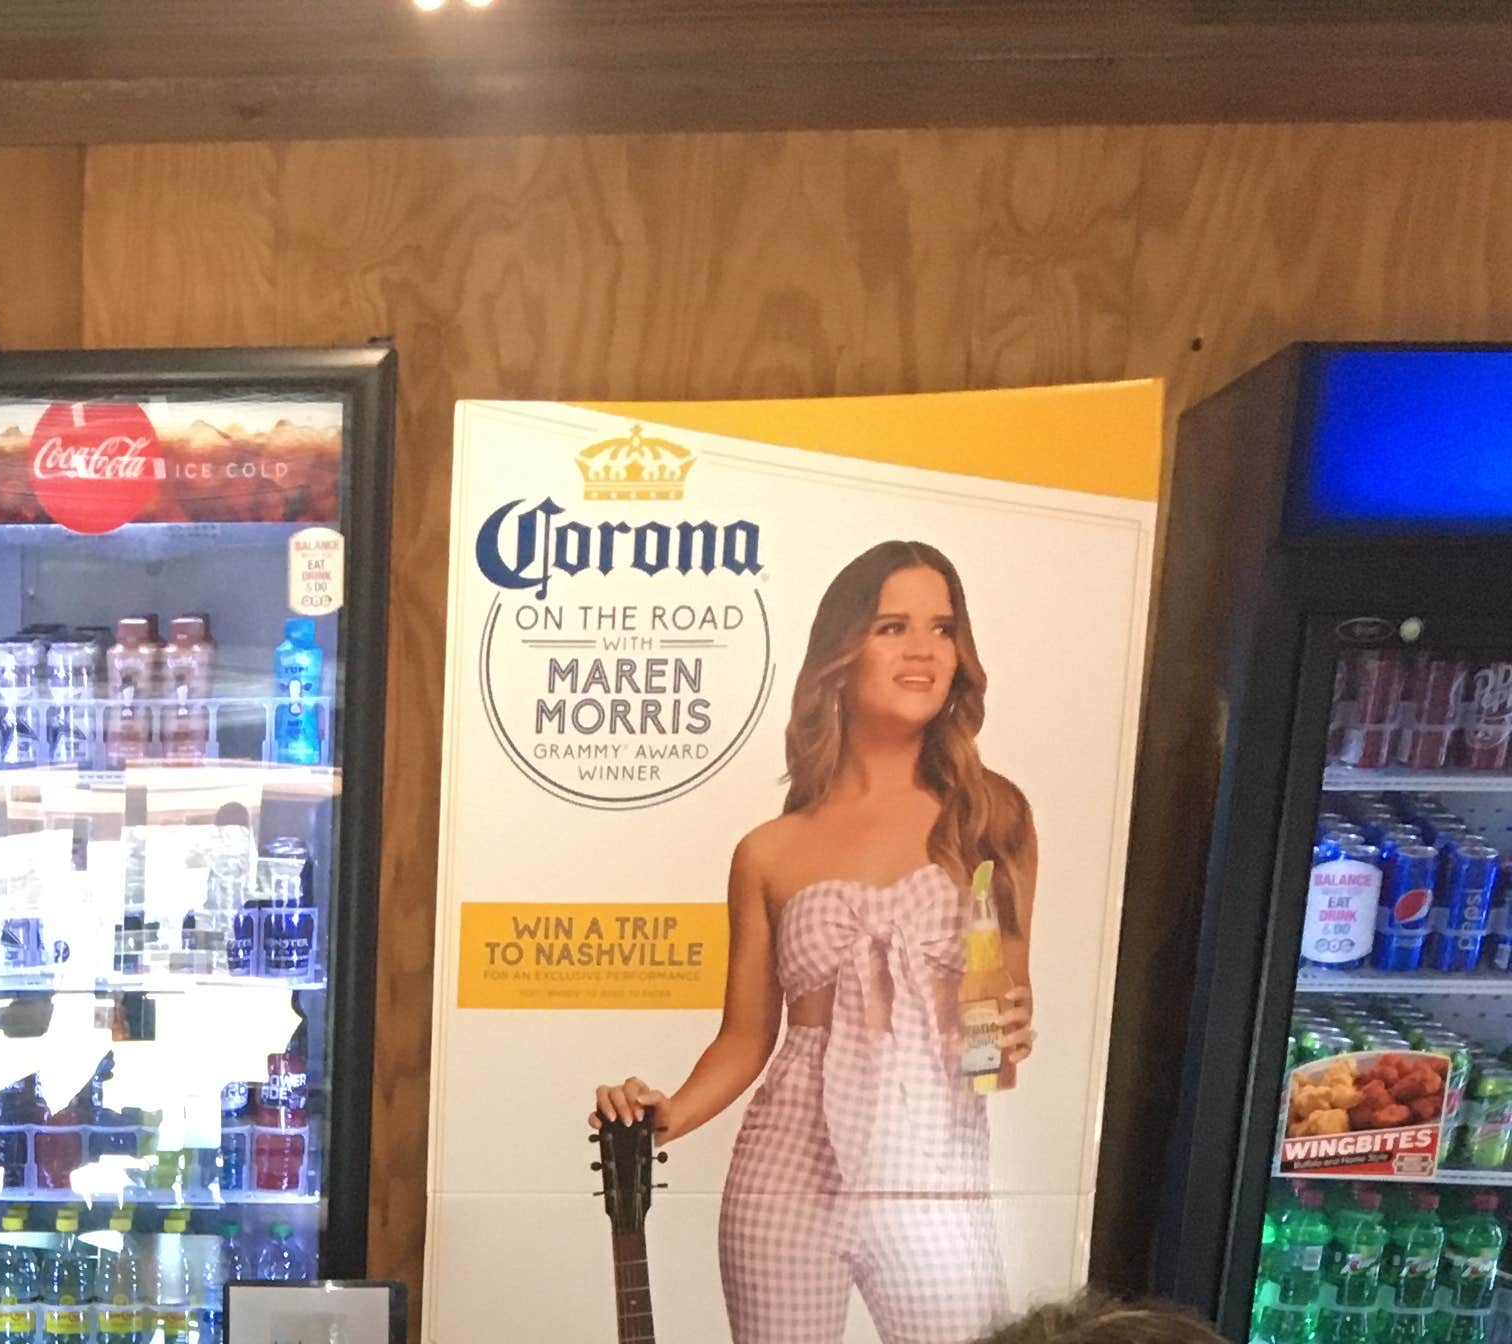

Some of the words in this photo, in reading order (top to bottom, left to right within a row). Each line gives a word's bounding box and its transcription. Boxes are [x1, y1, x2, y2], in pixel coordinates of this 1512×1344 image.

[33, 436, 152, 480] Coca-Cola
[175, 463, 212, 478] ICE
[226, 462, 288, 478] COLD
[294, 541, 339, 552] BALANCE
[475, 497, 765, 600] Corona
[307, 559, 325, 570] EAT
[302, 571, 331, 581] DRINK
[515, 606, 562, 630] ON
[579, 606, 637, 630] THE
[652, 605, 744, 630] ROAD
[603, 637, 653, 650] WITH
[548, 658, 702, 694] MAREN
[535, 699, 712, 735] MORRIS
[533, 744, 620, 760] GRAMMY
[635, 744, 710, 760] AWARD
[578, 766, 661, 781] WINNER
[1313, 873, 1373, 887] BALANCE
[1328, 897, 1352, 908] EAT
[1319, 909, 1358, 922] DRINK
[512, 916, 574, 940] WIN
[584, 916, 604, 940] A
[615, 916, 678, 940] TRIP
[485, 942, 524, 966] TO
[535, 942, 704, 966] NASHVILLE
[513, 970, 531, 981] AN
[535, 970, 601, 981] EXCLUSIVE
[605, 970, 702, 981] PERFORMANCE
[1285, 1129, 1433, 1161] WINGBITES
